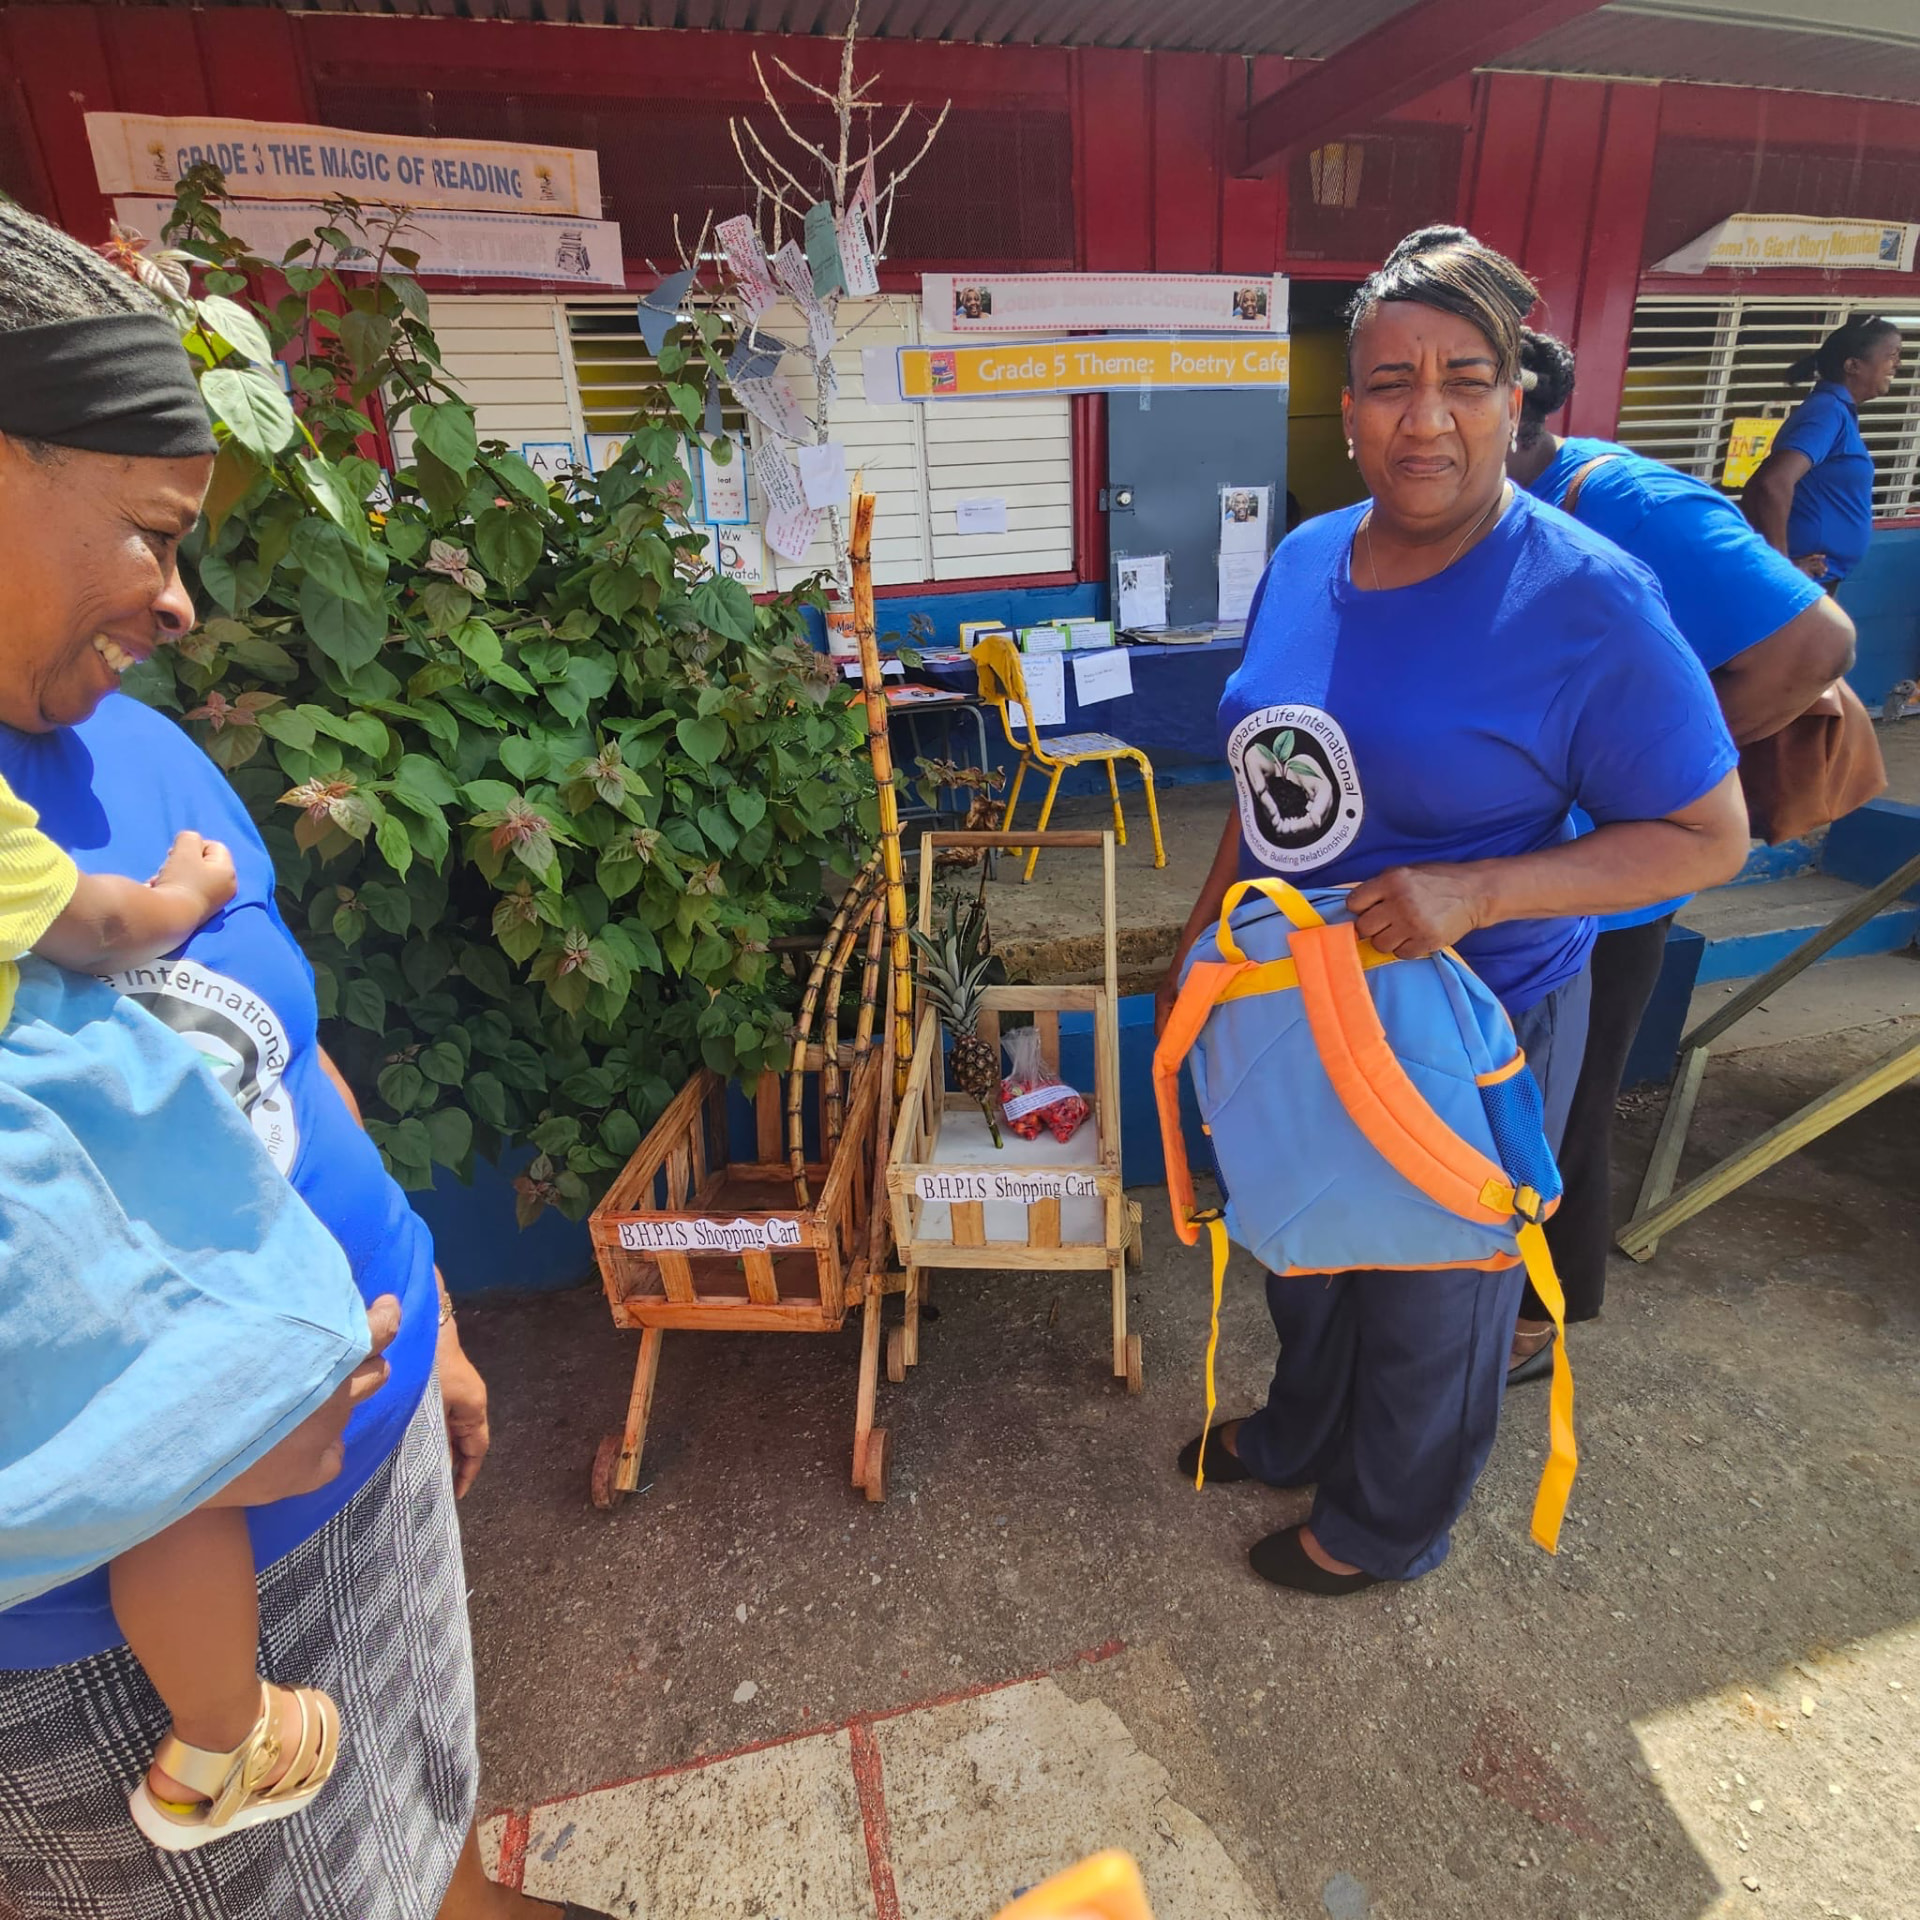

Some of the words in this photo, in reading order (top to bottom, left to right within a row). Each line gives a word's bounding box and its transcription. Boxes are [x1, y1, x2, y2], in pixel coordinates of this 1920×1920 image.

[177, 143, 248, 180] GRADE
[268, 144, 315, 176] THE
[320, 146, 390, 182] MAGIC
[397, 155, 425, 186] OF
[432, 158, 523, 198] READING
[978, 356, 1047, 381] Grade
[1055, 353, 1066, 376] 5
[1074, 352, 1155, 376] Theme:
[1170, 351, 1237, 378] Poetry
[1243, 350, 1287, 372] Cafe
[531, 452, 549, 471] A
[717, 475, 732, 484] leaf
[725, 567, 760, 580] watch
[1231, 716, 1262, 760] Impact
[1266, 707, 1296, 725] Life
[1297, 709, 1359, 796] International
[1269, 851, 1299, 866] Building
[1299, 823, 1350, 863] Relationships
[923, 1177, 987, 1199] B.H.P.I.S
[995, 1176, 1061, 1204] Shopping
[1066, 1175, 1096, 1197] Cart
[620, 1222, 688, 1247] B.H.P.I.S
[694, 1219, 766, 1250] Shopping
[767, 1220, 800, 1244] Cart
